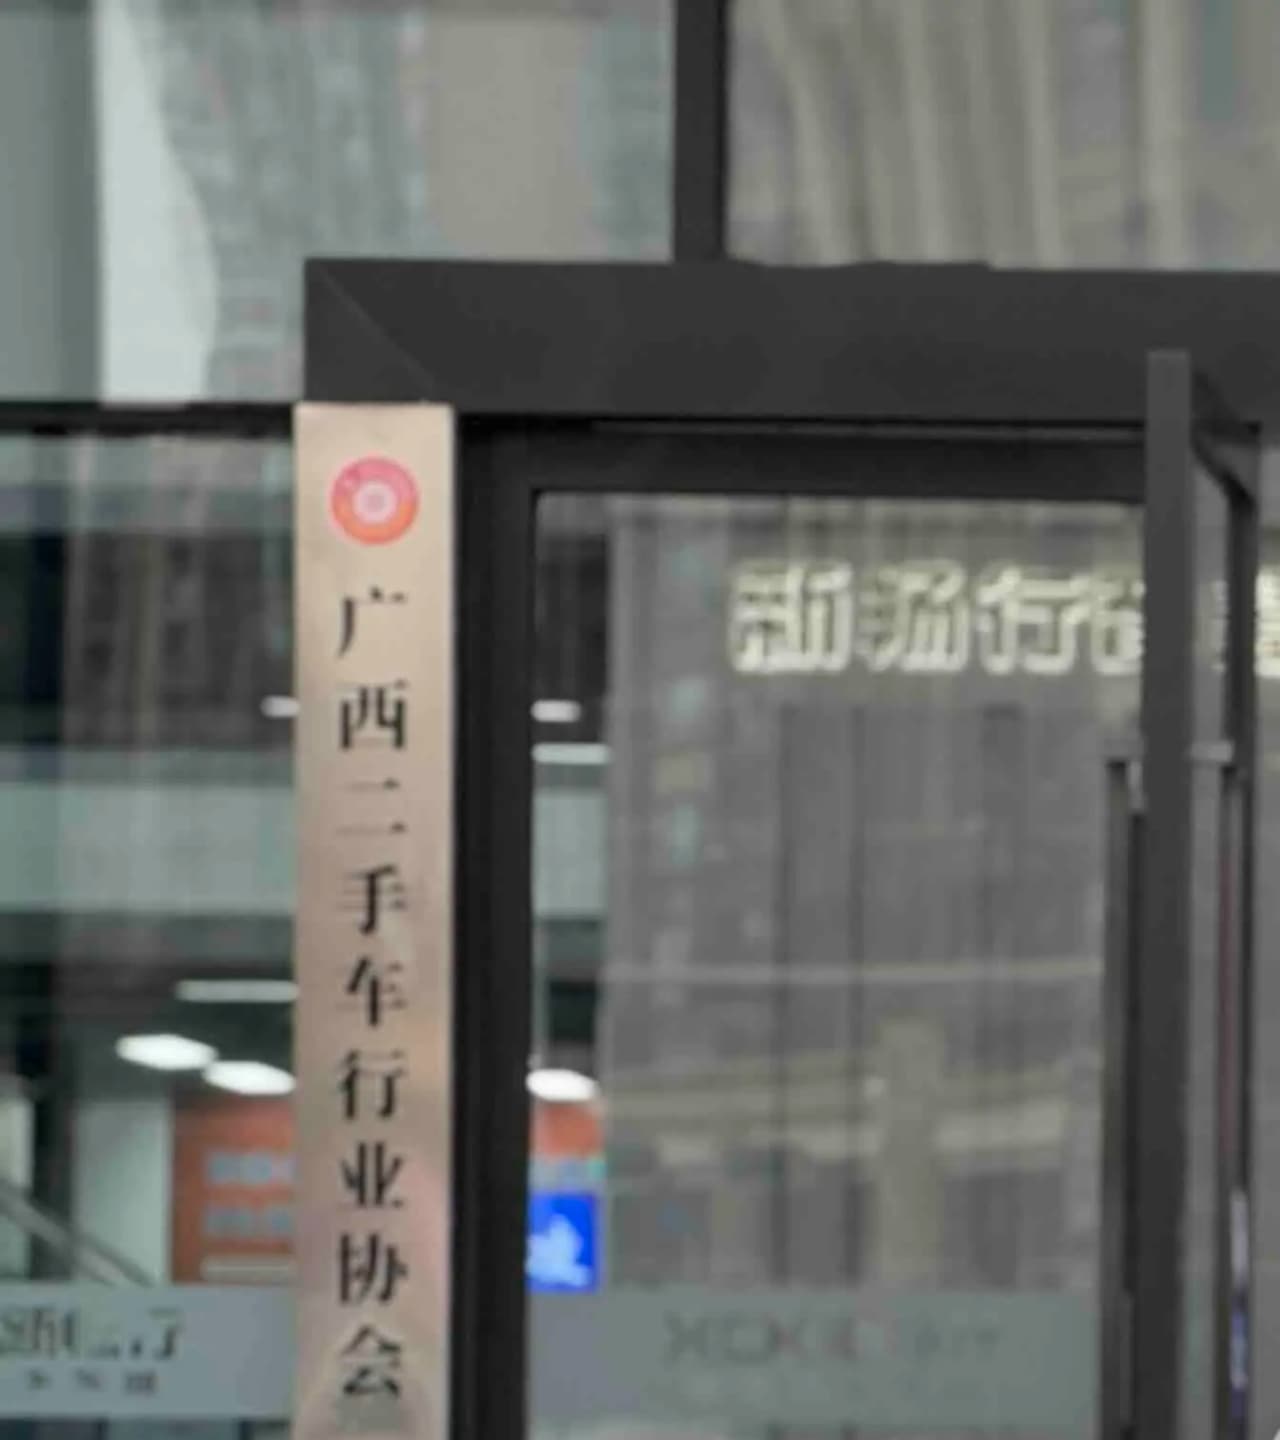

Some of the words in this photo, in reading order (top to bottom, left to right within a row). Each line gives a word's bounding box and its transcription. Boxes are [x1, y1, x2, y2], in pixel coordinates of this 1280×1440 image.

[335, 585, 410, 1400] 广西二手车行业协会
